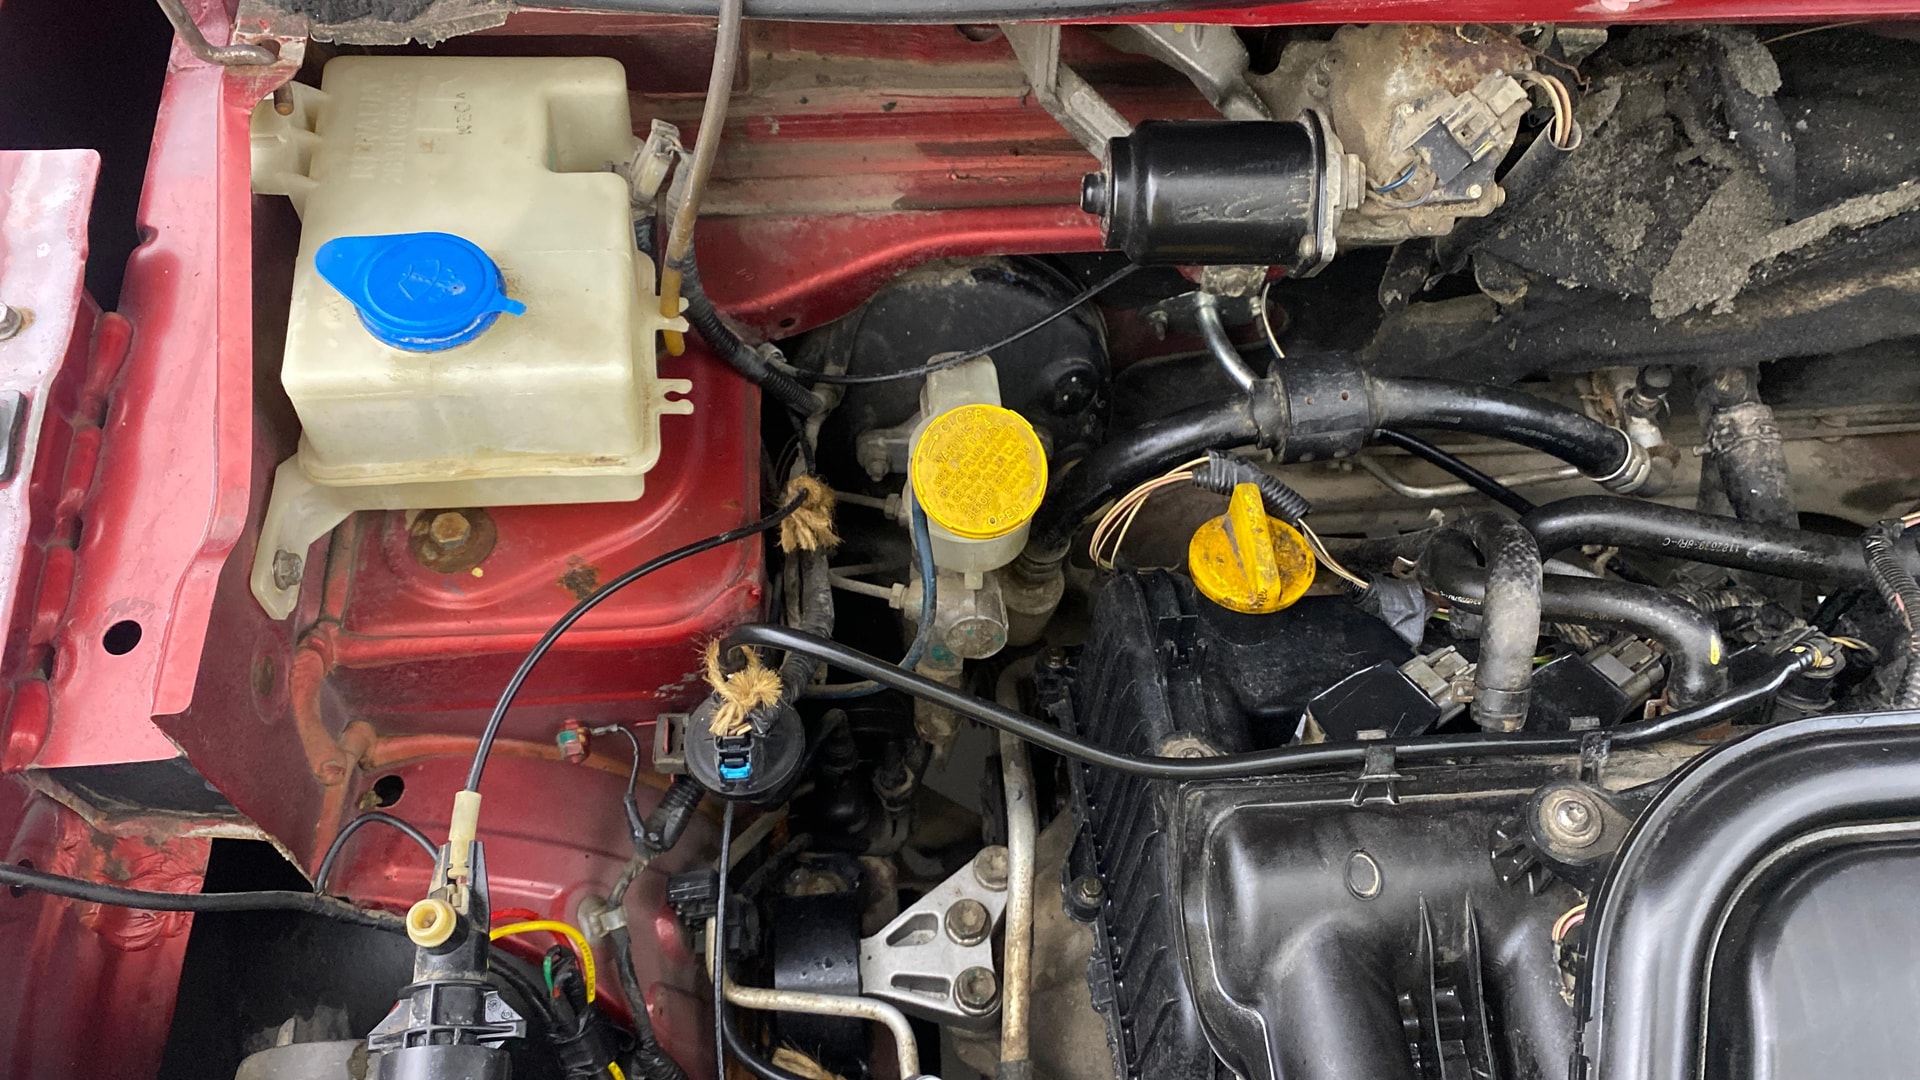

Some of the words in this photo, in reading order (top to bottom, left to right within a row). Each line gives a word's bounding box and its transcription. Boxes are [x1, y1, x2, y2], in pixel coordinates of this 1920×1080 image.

[940, 409, 983, 434] CLOSE
[935, 424, 973, 465] WARNING
[963, 445, 987, 471] FLUID
[965, 486, 996, 520] BEFORE
[988, 503, 1024, 526] OPEN
